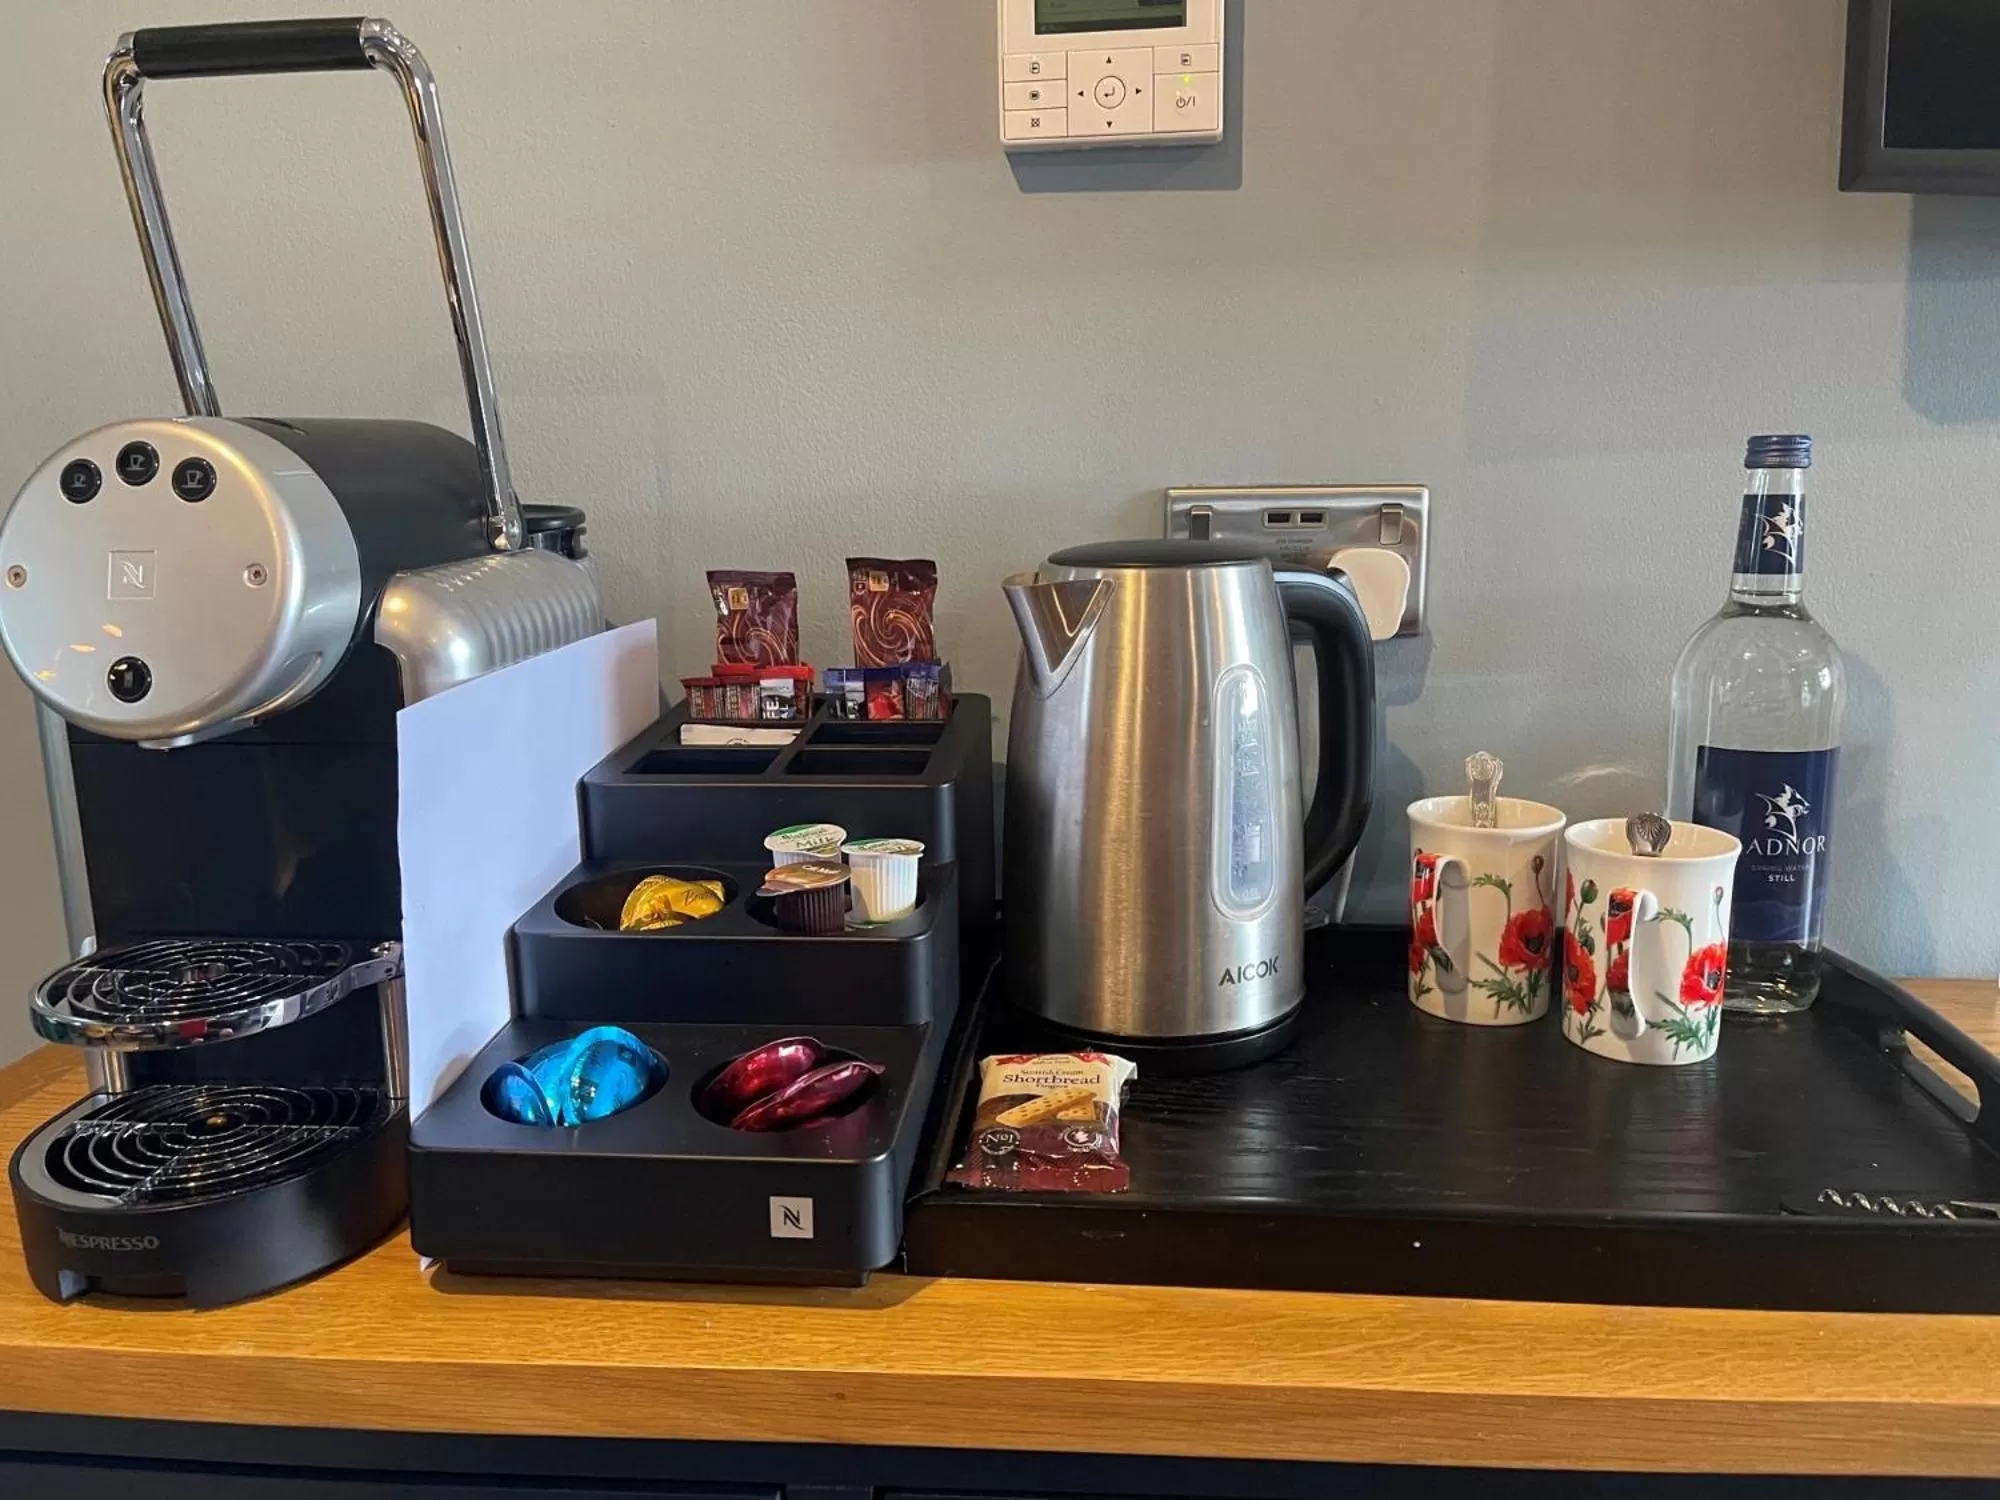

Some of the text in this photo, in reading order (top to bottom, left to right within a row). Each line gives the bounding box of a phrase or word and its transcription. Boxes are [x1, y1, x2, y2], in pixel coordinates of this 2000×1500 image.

[796, 837, 834, 849] Milk
[1746, 835, 1826, 857] ADNOR
[1768, 874, 1796, 883] STILL
[1218, 955, 1281, 987] AICOK
[1002, 1073, 1101, 1085] Shortbread
[56, 1226, 161, 1251] NESPRESSO
